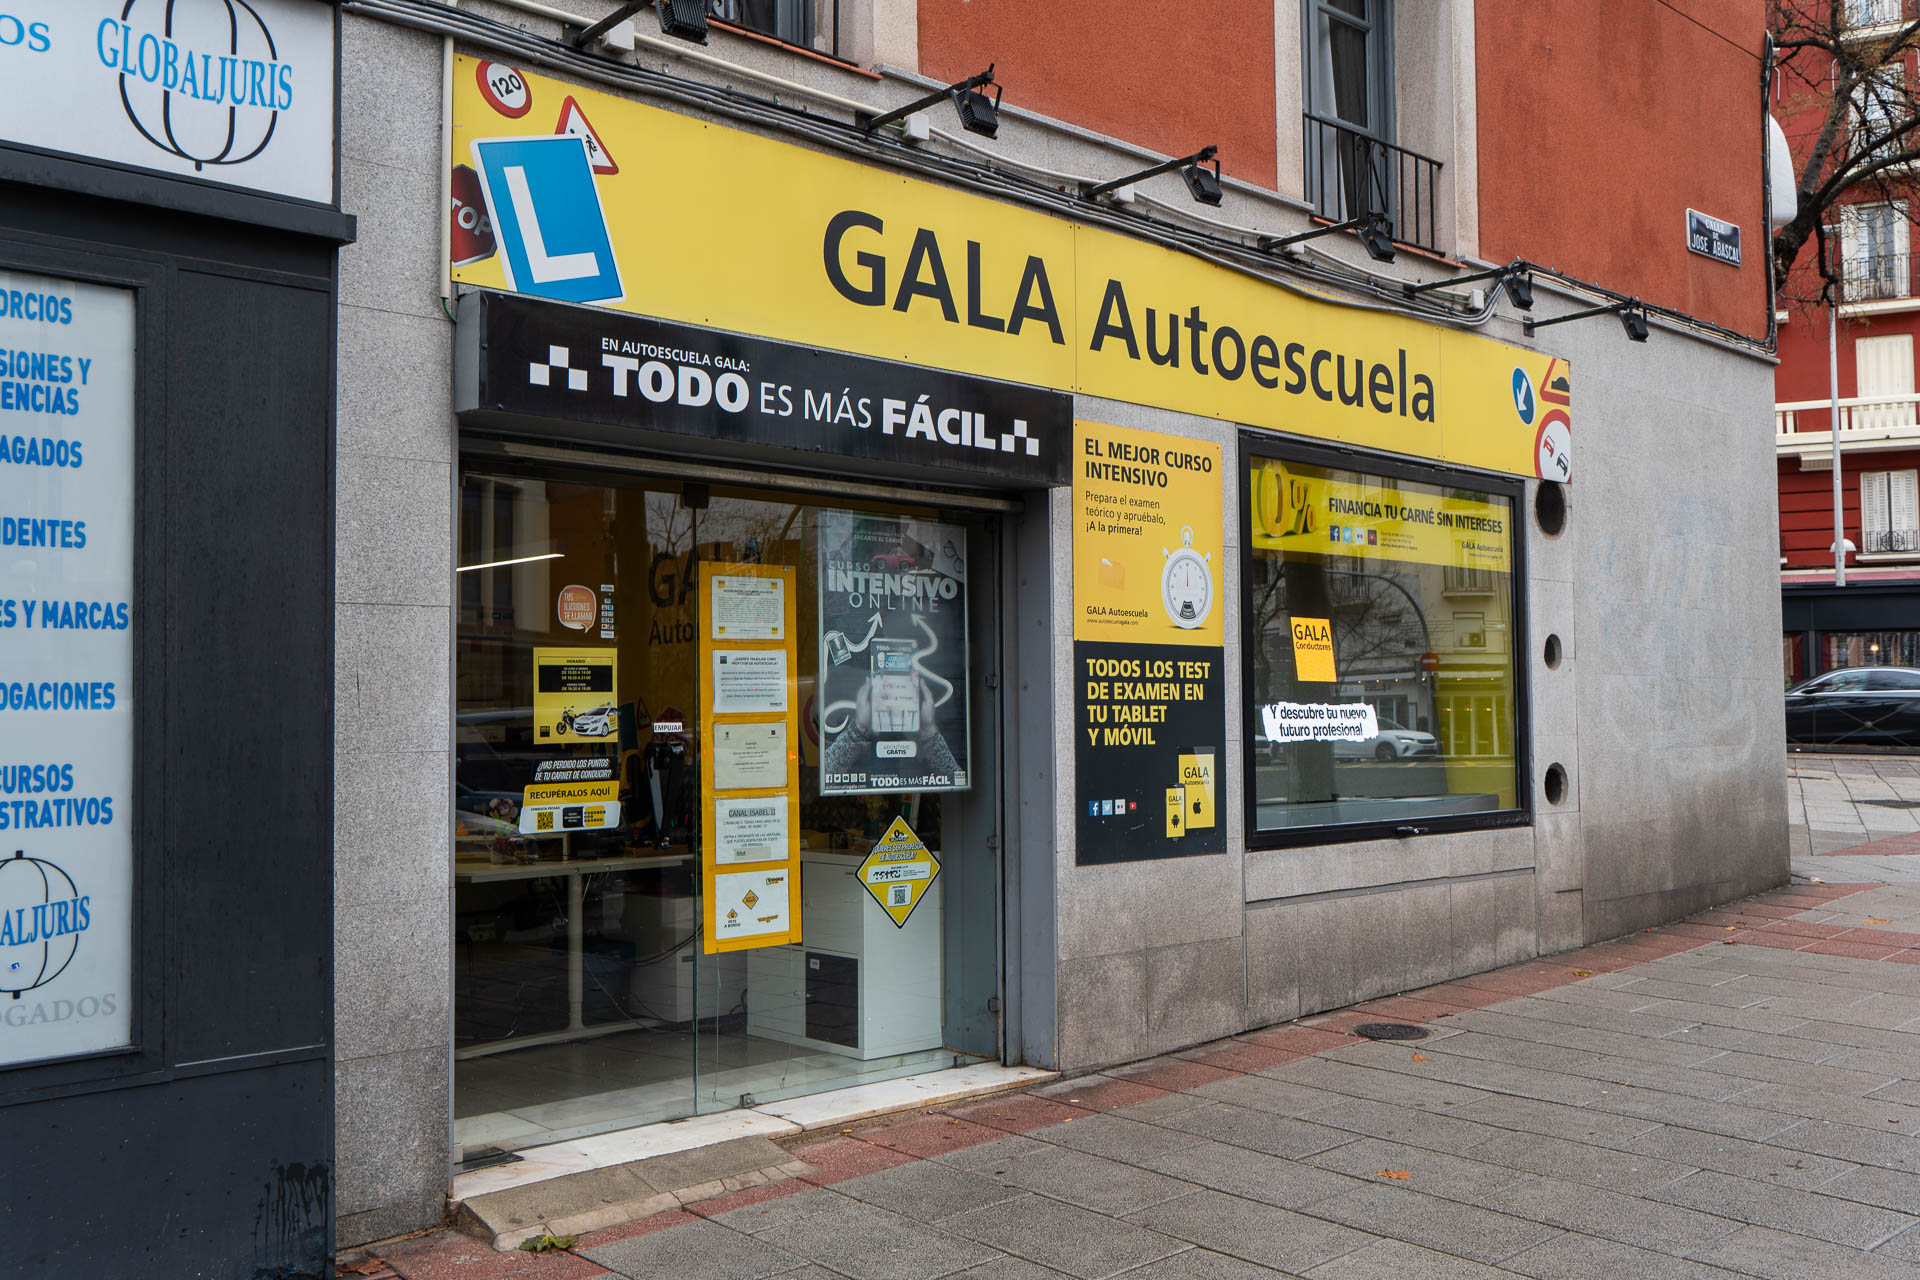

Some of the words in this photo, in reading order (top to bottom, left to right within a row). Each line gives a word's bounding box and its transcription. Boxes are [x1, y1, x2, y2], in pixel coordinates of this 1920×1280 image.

[0, 15, 52, 53] OS
[97, 17, 293, 111] GLOBALJURIS
[491, 73, 522, 98] 120
[503, 165, 601, 284] L
[1712, 240, 1740, 262] ABASCAL
[823, 210, 1066, 345] GALA
[1090, 279, 1435, 424] Autoescuela
[602, 337, 619, 352] EN
[622, 341, 711, 366] AUTOESCUELA
[714, 356, 750, 373] GALA:
[78, 357, 91, 385] Y
[602, 353, 750, 413] TODO
[760, 381, 793, 417] ES
[804, 387, 872, 429] MÁS
[882, 394, 996, 450] FÁCIL
[1085, 437, 1103, 458] EL
[1108, 441, 1160, 465] MEJOR
[1164, 450, 1212, 473] CURSO
[1085, 461, 1168, 488] INTENSIVO
[1085, 490, 1118, 505] Prepara
[1119, 494, 1127, 505] el
[1129, 497, 1160, 509] examen
[1257, 462, 1316, 537] 0%
[1086, 506, 1115, 519] teórico
[1116, 510, 1122, 521] y
[1123, 511, 1166, 526] apruébalo,
[1329, 497, 1382, 518] FINANCIA
[1384, 504, 1398, 520] TU
[1400, 507, 1434, 525] CARNÉ
[1436, 511, 1453, 528] SIN
[1455, 514, 1503, 534] INTERESES
[1086, 521, 1096, 533] ¡A
[1098, 522, 1106, 532] la
[1108, 523, 1143, 536] primera!
[1462, 541, 1475, 550] GALA
[828, 560, 871, 571] CURSO
[828, 569, 958, 600] INTENSIVO
[564, 592, 574, 601] TUS
[849, 592, 940, 613] ONLINE
[22, 600, 37, 628] Y
[42, 601, 129, 630] MARCAS
[1086, 605, 1106, 616] GALA
[1108, 607, 1148, 618] Autoescuela
[1294, 623, 1330, 641] GALA
[1295, 641, 1331, 651] Conductores
[1086, 658, 1141, 677] TODOS
[1145, 660, 1174, 678] LOS
[1177, 661, 1211, 679] TEST
[1087, 682, 1109, 700] DE
[1113, 682, 1180, 700] EXAMEN
[1184, 683, 1204, 701] EN
[1087, 705, 1108, 722] TU
[1111, 705, 1167, 723] TABLET
[1271, 706, 1277, 719] Y
[1280, 706, 1325, 719] descubre
[1326, 706, 1337, 719] tu
[1340, 709, 1367, 719] nuevo
[1087, 727, 1099, 746] Y
[1104, 724, 1156, 746] MÓVIL
[1280, 722, 1310, 737] futuro
[1313, 722, 1363, 739] profesional
[576, 759, 587, 768] LOS
[588, 758, 609, 768] PUNTOS
[1184, 766, 1209, 778] GALA
[0, 763, 73, 793] URSOS
[534, 771, 542, 781] DE
[543, 771, 551, 780] TU
[551, 770, 572, 780] CARNET
[572, 770, 580, 779] DE
[870, 777, 899, 787] TODO
[900, 777, 907, 785] ES
[908, 775, 922, 785] MÁS
[922, 773, 951, 785] FÁCIL
[529, 788, 588, 800] RECUPÉRALOS
[590, 786, 610, 796] AQUÍ
[729, 809, 748, 818] CANAL
[750, 808, 769, 817] ISABEL
[770, 808, 776, 816] II
[0, 993, 117, 1027] GADOS
